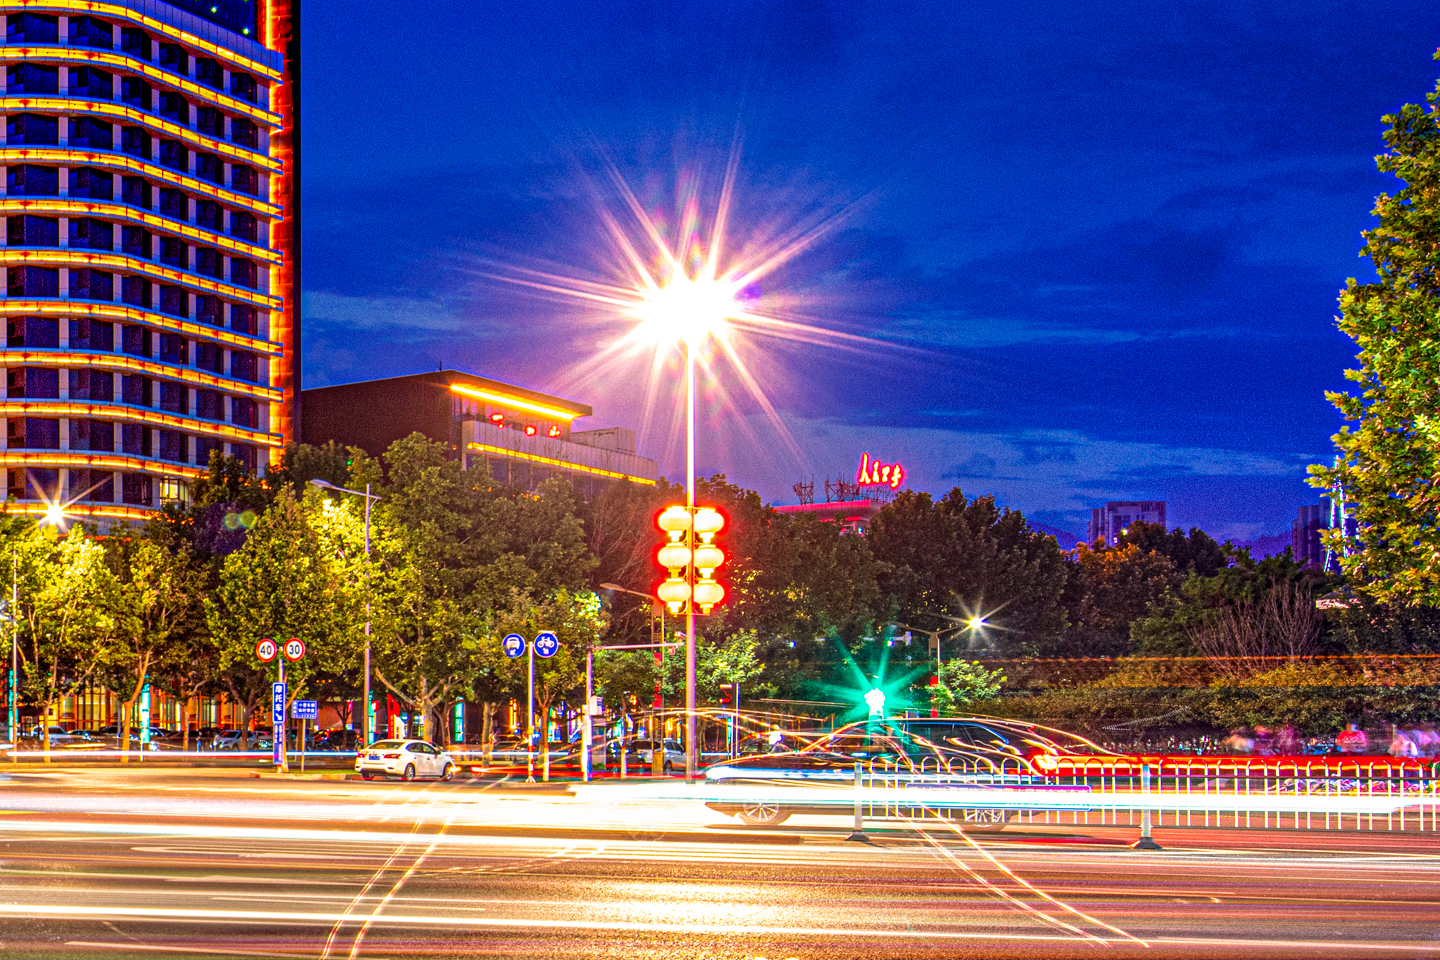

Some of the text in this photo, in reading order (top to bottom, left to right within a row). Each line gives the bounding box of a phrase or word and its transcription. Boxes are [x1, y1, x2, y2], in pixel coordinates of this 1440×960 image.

[260, 645, 272, 655] 40
[288, 644, 300, 655] 30
[274, 685, 283, 711] 摩托车
